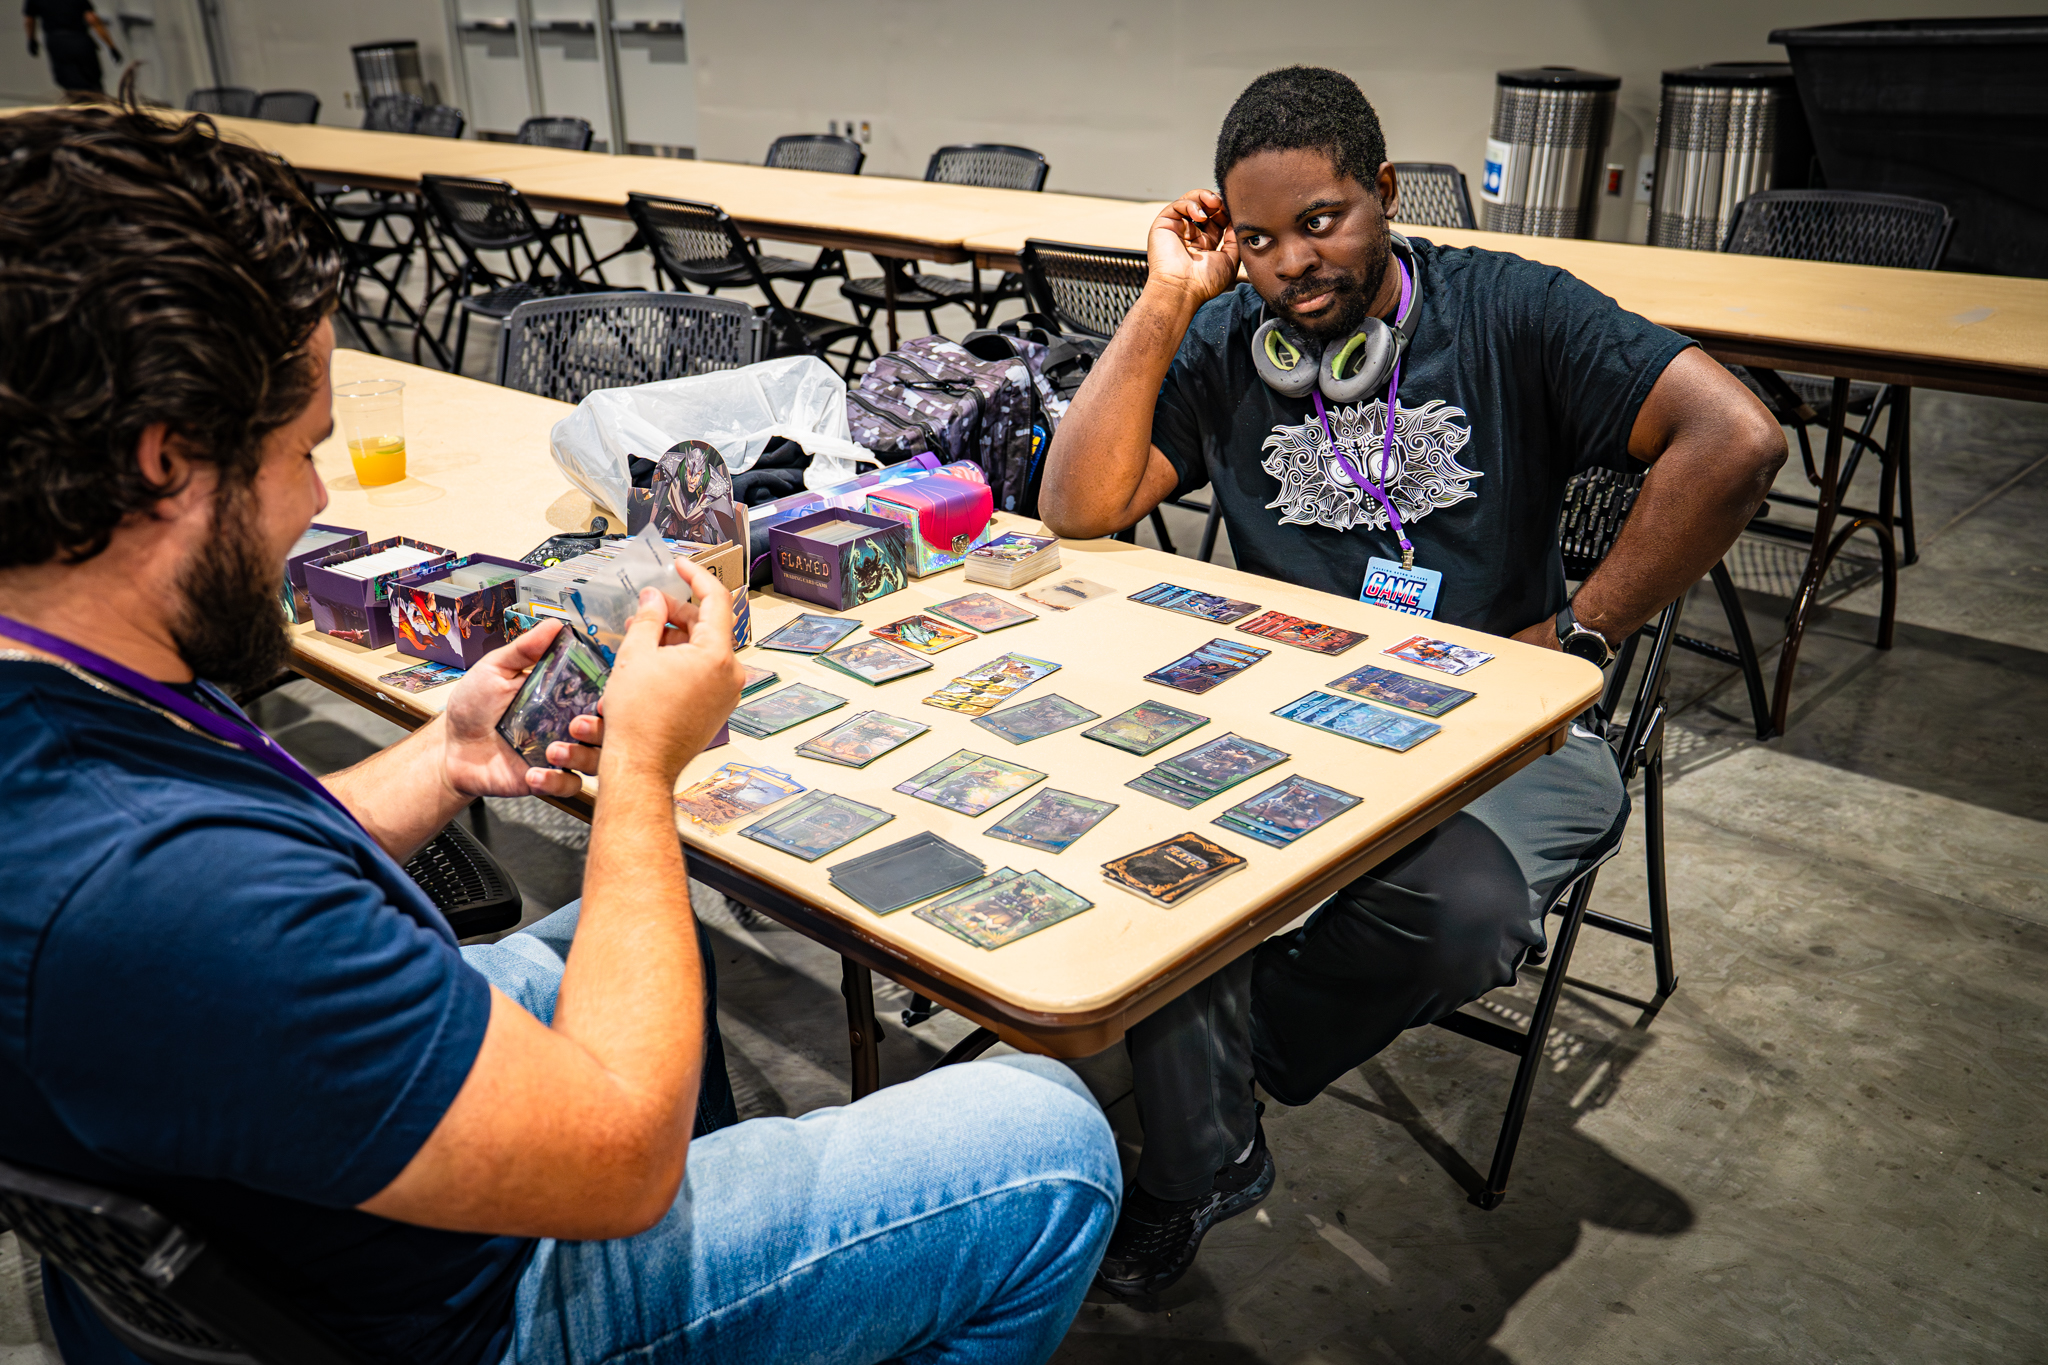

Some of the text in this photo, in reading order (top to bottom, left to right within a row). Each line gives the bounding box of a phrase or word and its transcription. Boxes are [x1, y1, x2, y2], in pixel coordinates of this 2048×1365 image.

[781, 552, 829, 577] FLAWED
[1365, 572, 1424, 607] GAME
[1373, 598, 1389, 608] AND
[1165, 847, 1207, 870] FLAWED
